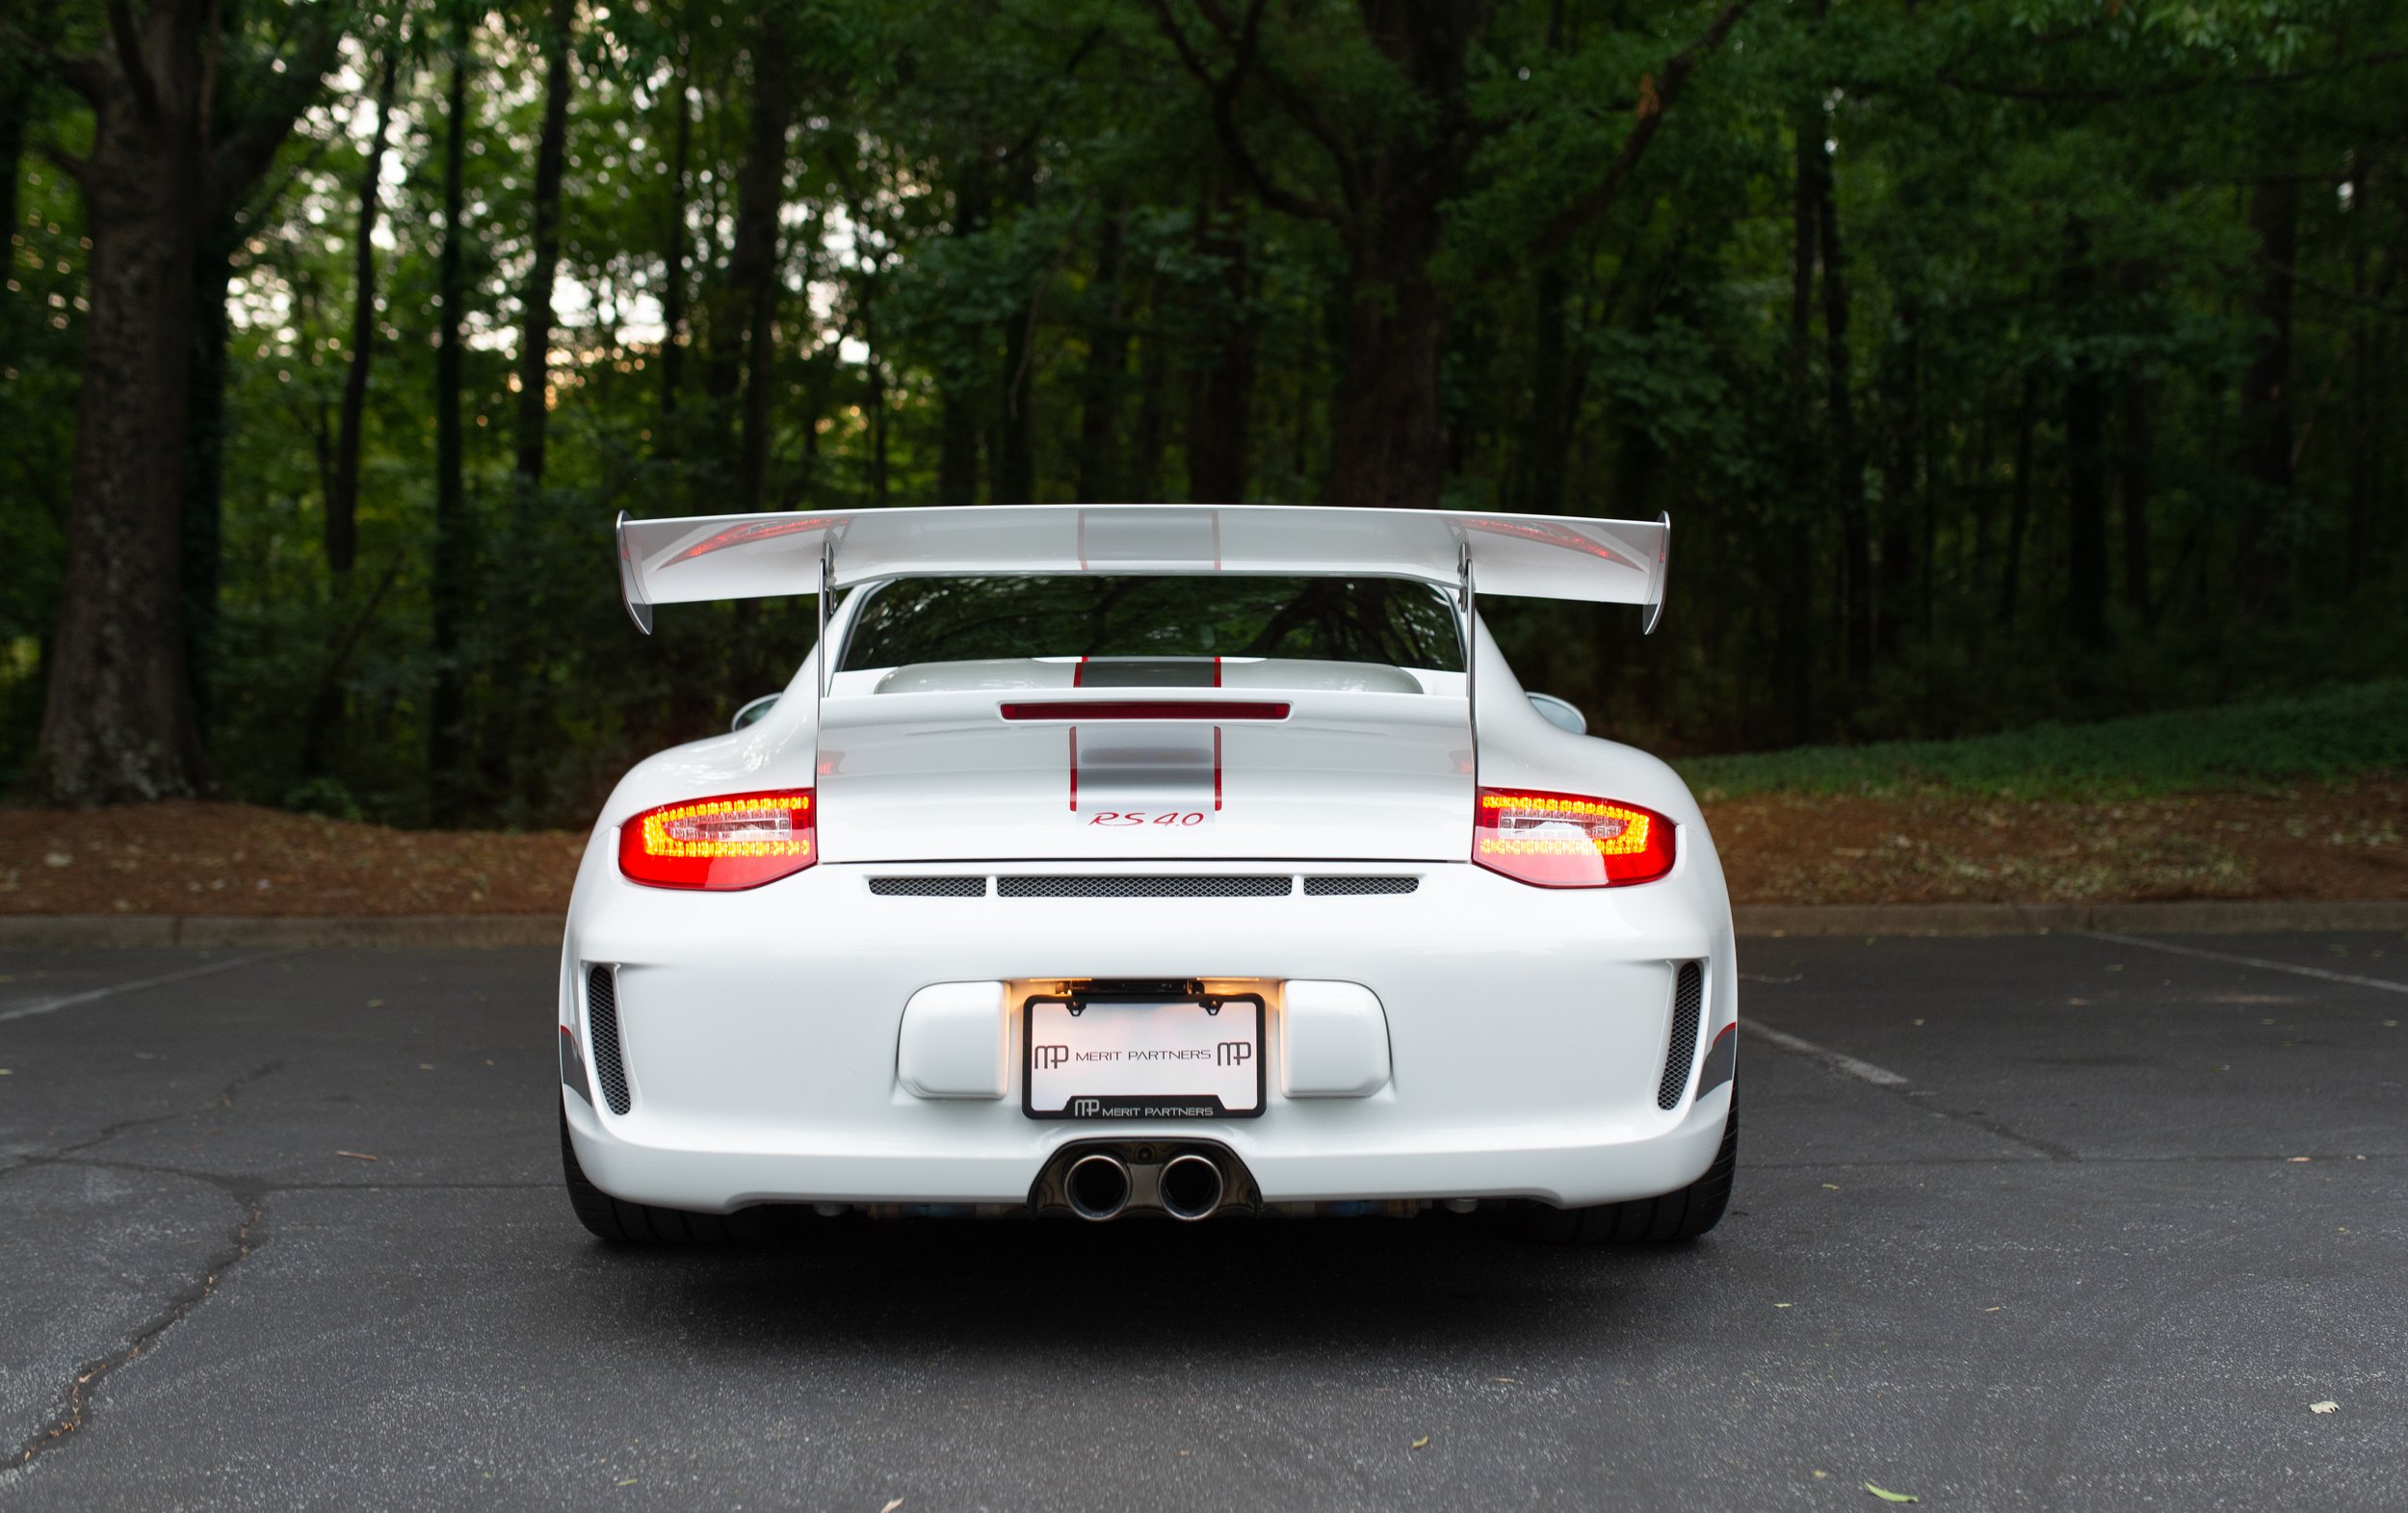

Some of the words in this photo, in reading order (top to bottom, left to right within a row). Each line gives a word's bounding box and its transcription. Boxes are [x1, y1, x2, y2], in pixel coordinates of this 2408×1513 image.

[1087, 812, 1146, 826] RS
[1153, 812, 1204, 826] 4.0
[1075, 1051, 1122, 1061] MERIT
[1128, 1050, 1212, 1061] PARTNERS
[1102, 1108, 1140, 1117] MERIT
[1144, 1107, 1214, 1117] PARTNERS
